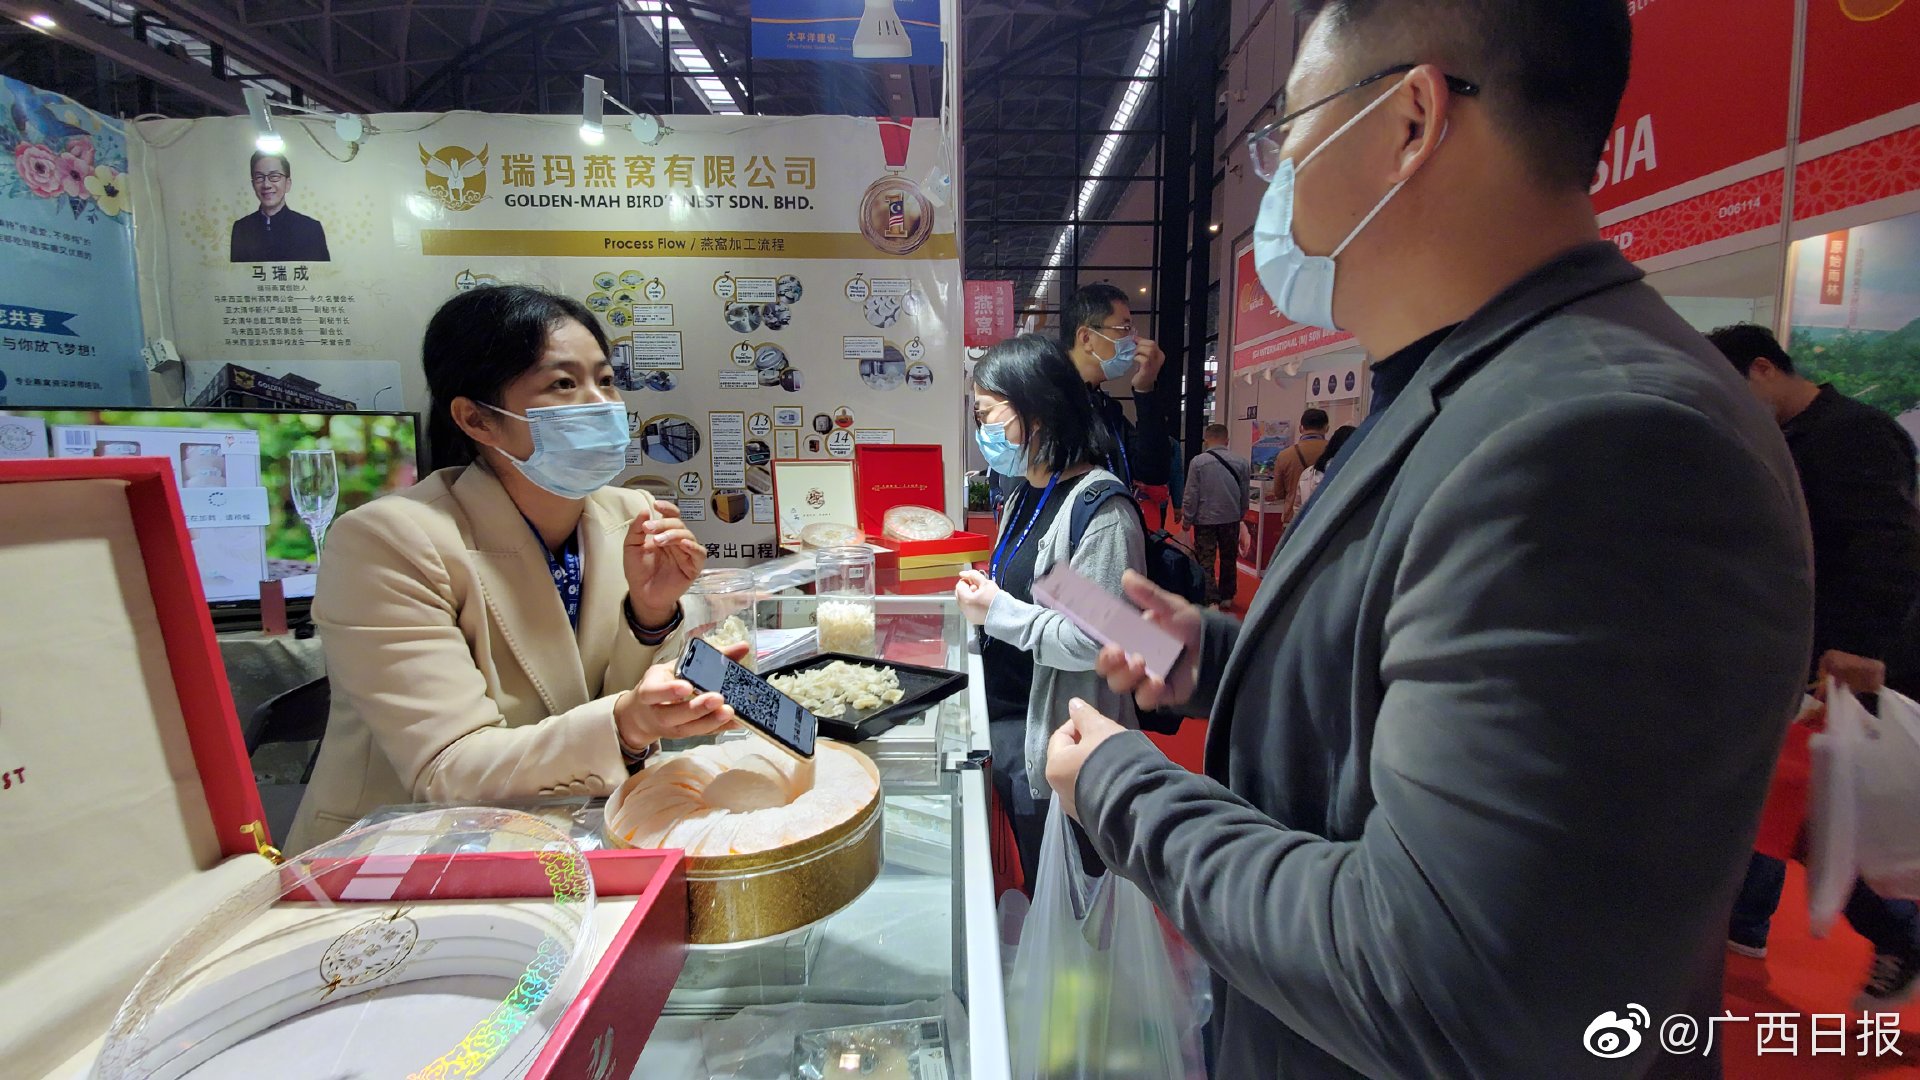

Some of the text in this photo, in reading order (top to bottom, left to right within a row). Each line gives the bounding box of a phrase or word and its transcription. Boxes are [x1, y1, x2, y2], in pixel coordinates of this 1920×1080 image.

[501, 153, 816, 190] 瑞玛燕窝有限公司
[504, 194, 621, 209] GOLDEN-MAH
[683, 195, 725, 209] NEST
[729, 195, 769, 210] SDN.
[774, 196, 814, 210] BHD.
[1718, 196, 1761, 218] D06114
[604, 237, 654, 250] Process
[657, 238, 686, 250] Flow
[252, 265, 310, 282] 马瑞成
[1826, 240, 1845, 297] 原始雨林
[741, 339, 750, 351] 6
[912, 336, 920, 349] 8
[753, 414, 769, 427] 13
[834, 431, 850, 443] 14
[684, 472, 698, 484] 12
